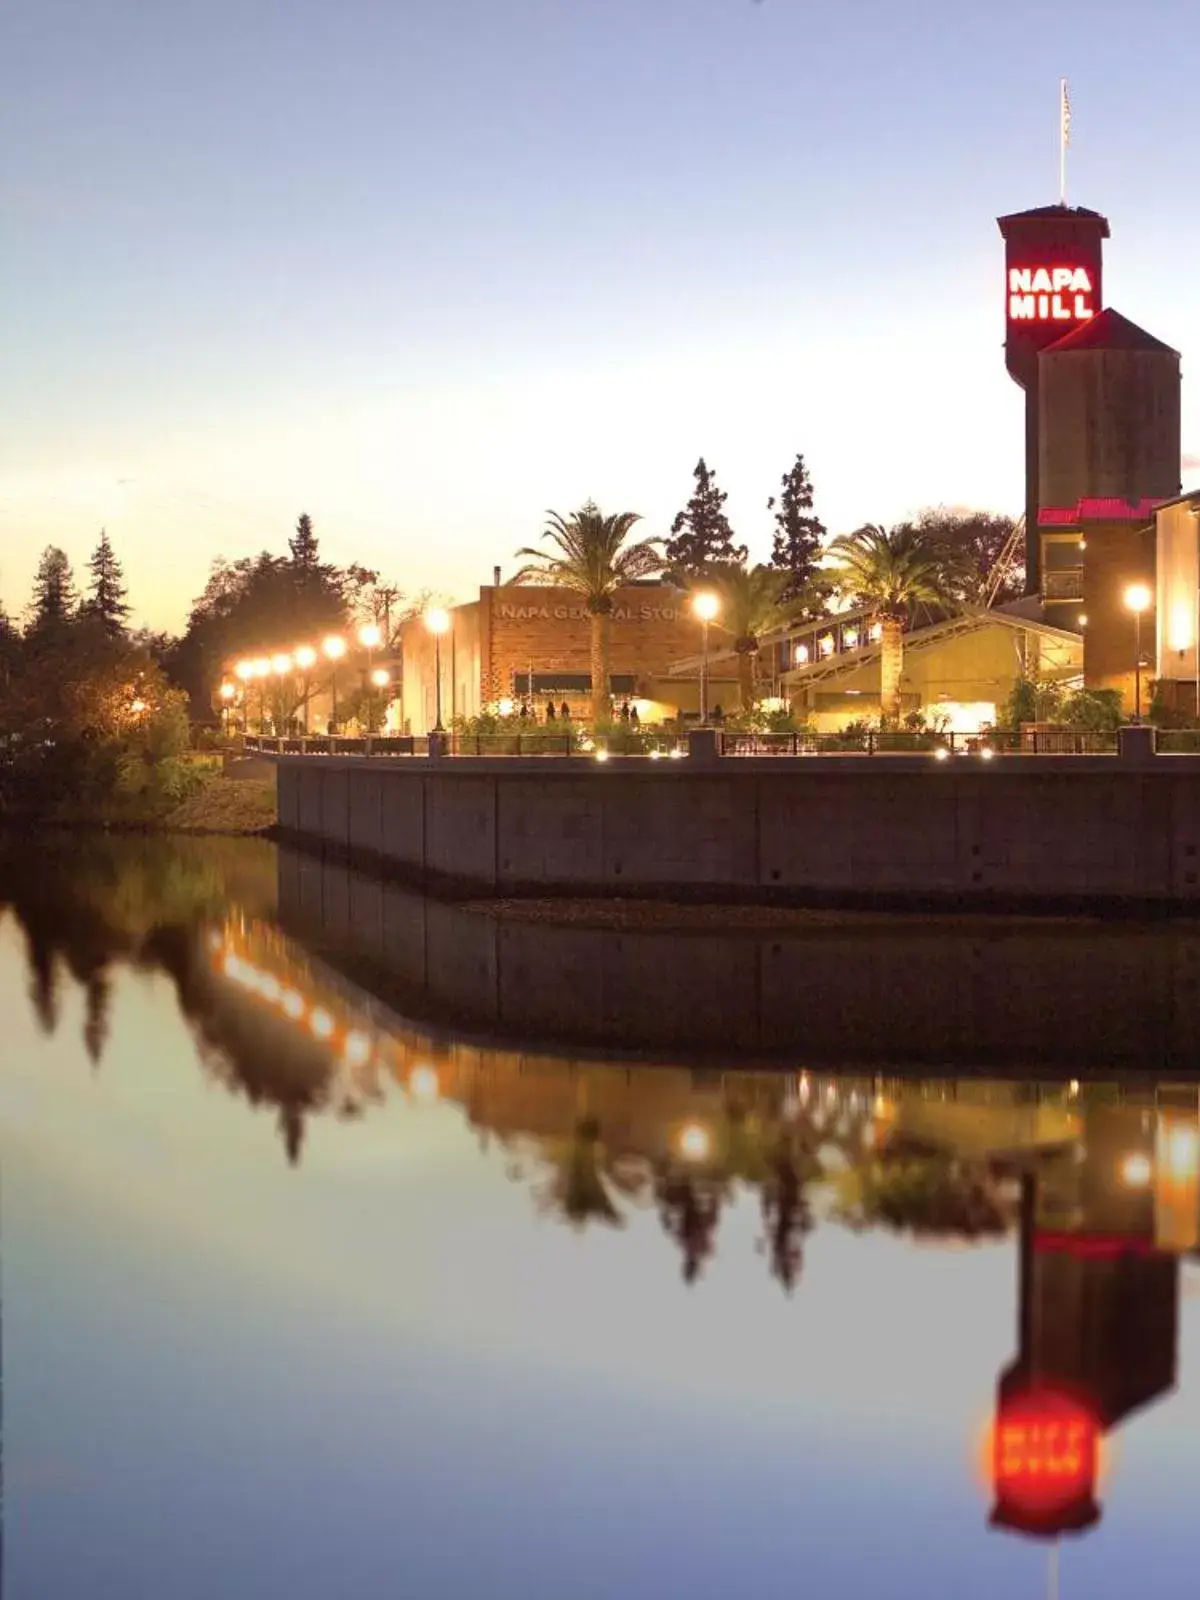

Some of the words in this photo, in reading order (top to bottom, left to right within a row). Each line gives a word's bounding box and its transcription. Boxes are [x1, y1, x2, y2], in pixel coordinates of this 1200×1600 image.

[1009, 267, 1092, 292] NAPA
[1010, 294, 1093, 319] MILL
[501, 604, 549, 619] NAPA
[554, 605, 637, 620] GENAL
[640, 606, 684, 620] STO
